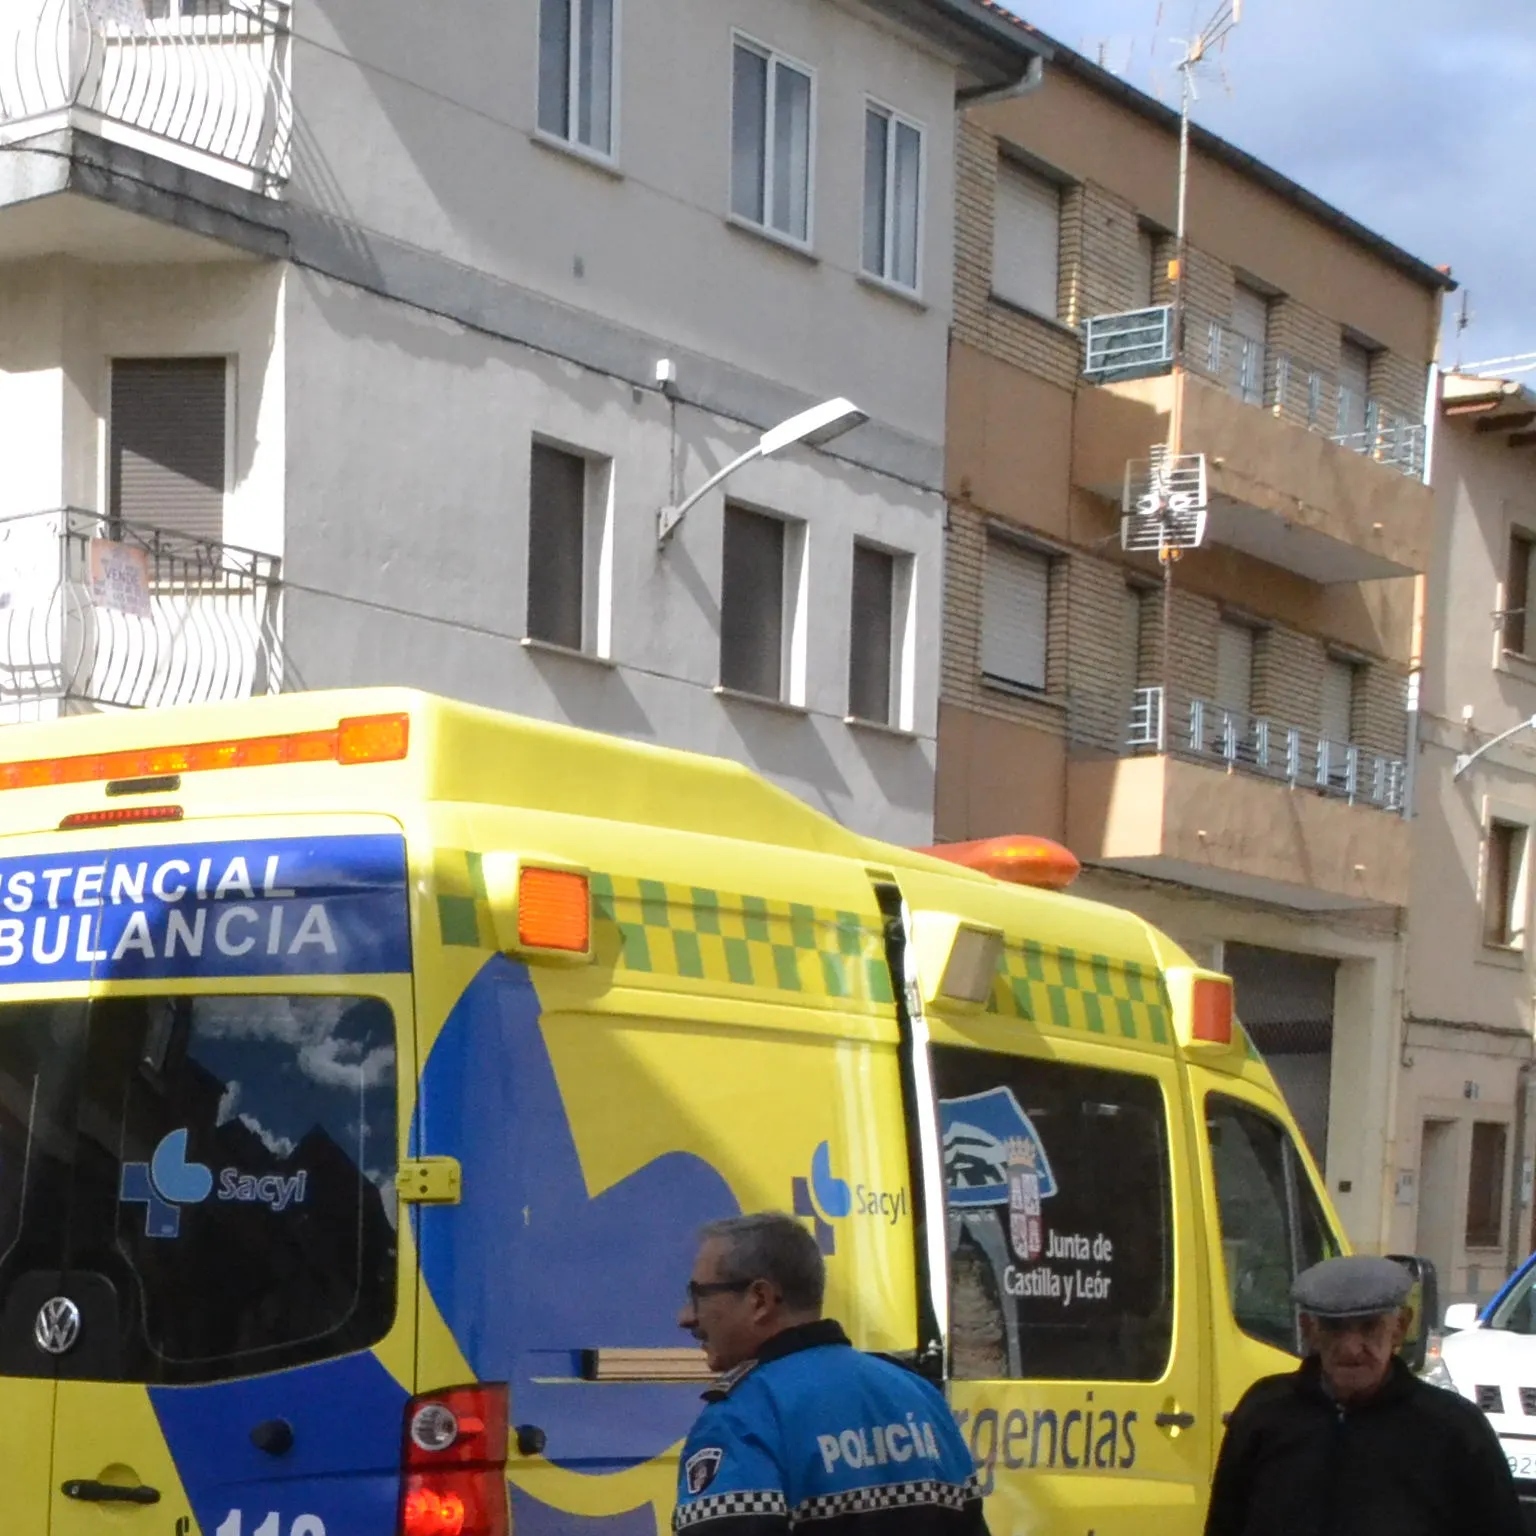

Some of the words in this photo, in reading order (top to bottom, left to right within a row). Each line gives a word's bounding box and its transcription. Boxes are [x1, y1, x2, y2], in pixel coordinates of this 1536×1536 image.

[216, 1165, 308, 1212] Sacyl
[855, 1183, 907, 1226] Sacyl
[1044, 1227, 1091, 1261] Junta
[1092, 1231, 1114, 1262] de
[1003, 1264, 1061, 1297] Castilla
[1063, 1274, 1074, 1308] y
